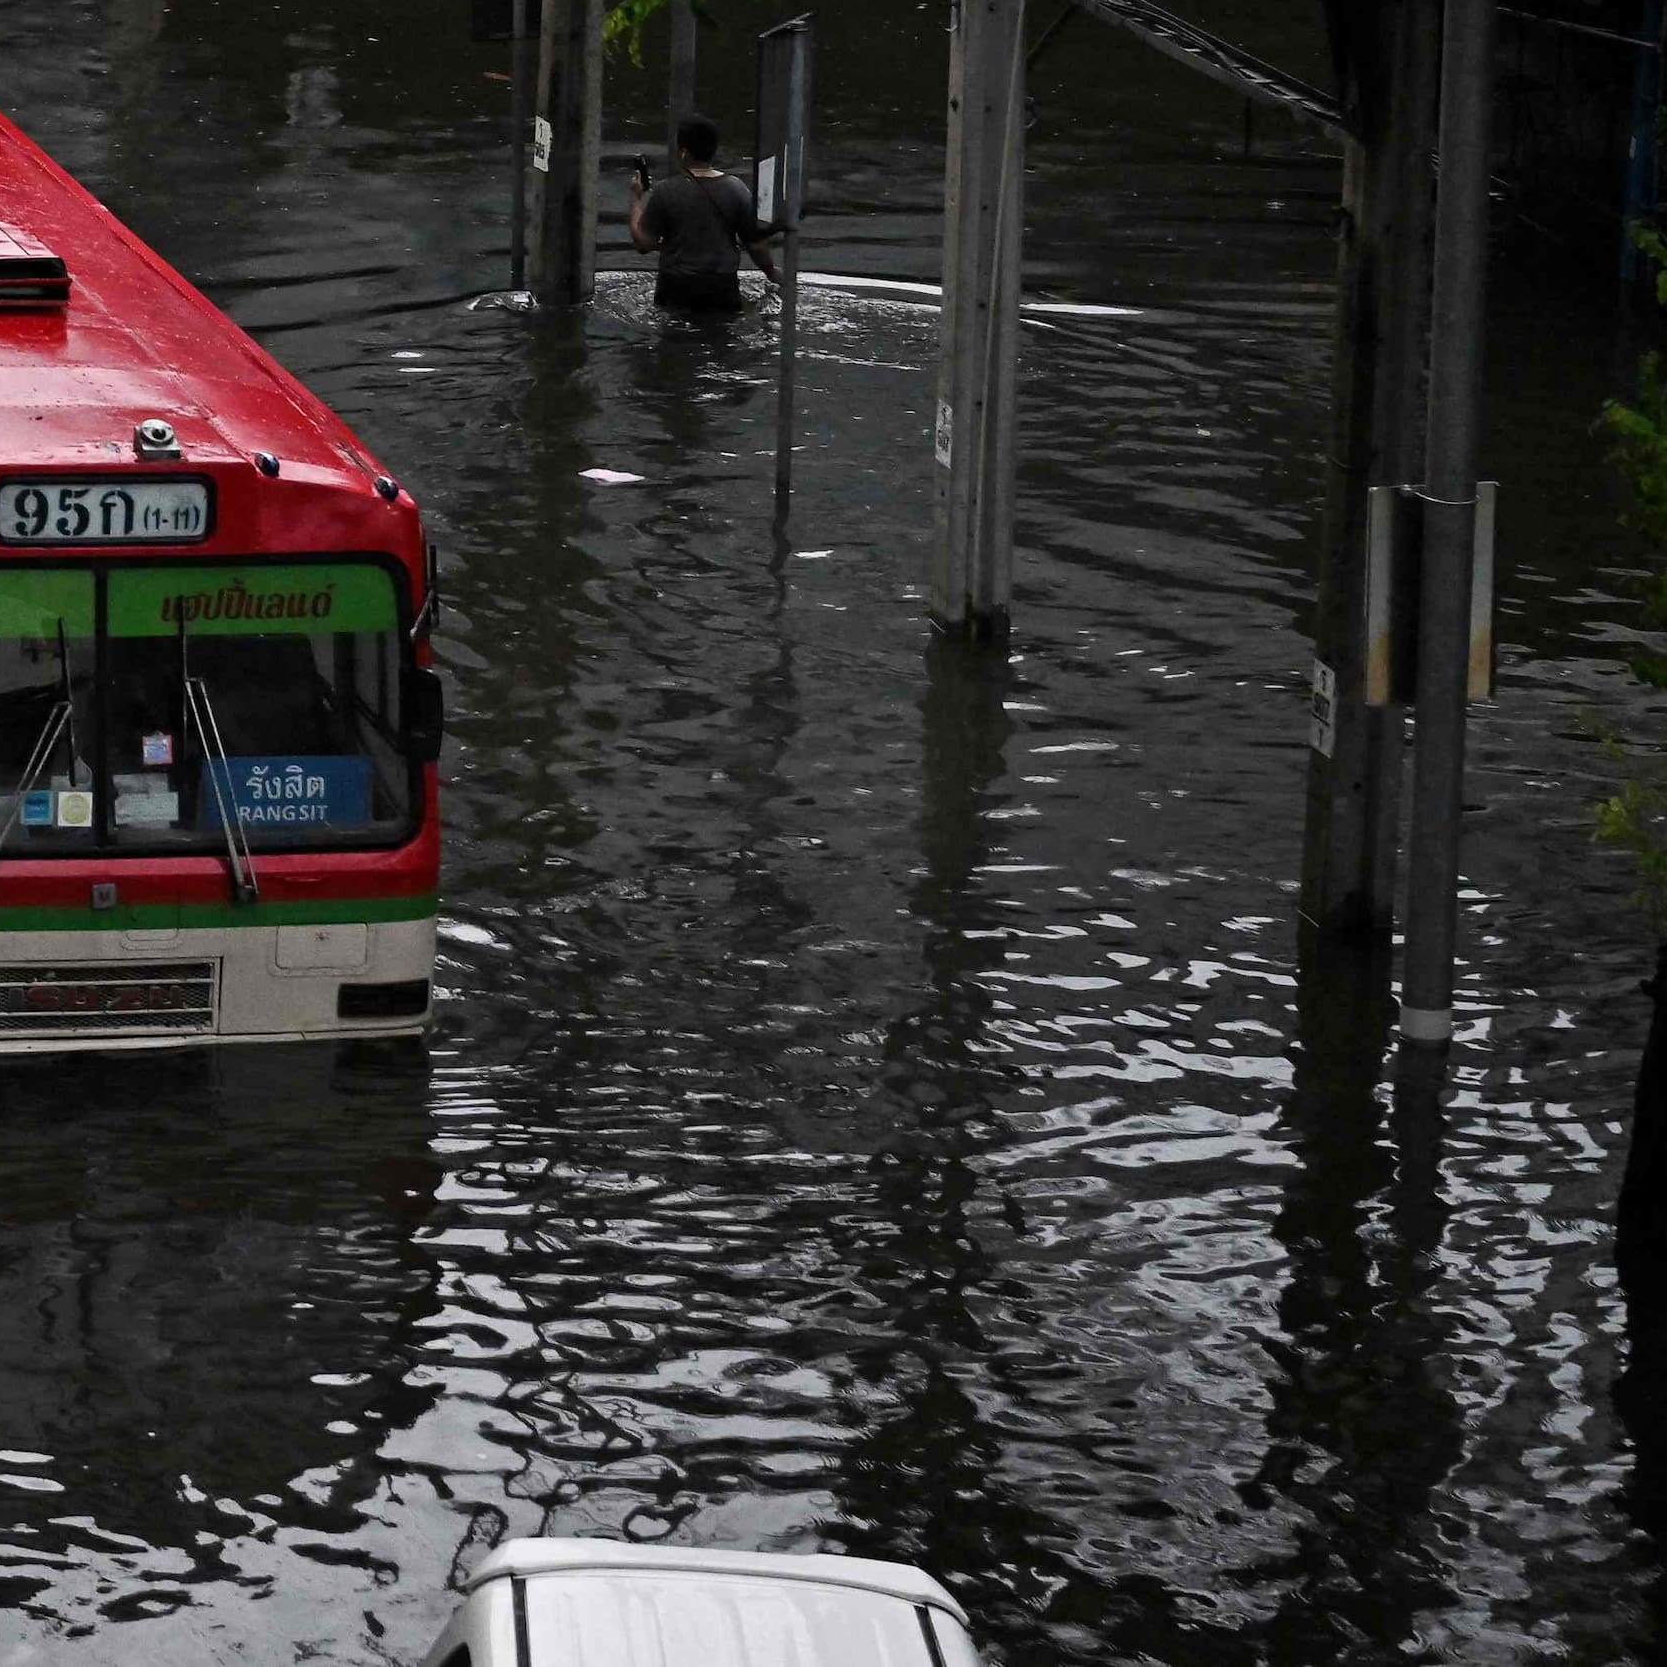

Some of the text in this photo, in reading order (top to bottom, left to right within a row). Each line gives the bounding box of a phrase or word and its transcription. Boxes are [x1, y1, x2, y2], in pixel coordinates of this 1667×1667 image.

[13, 487, 201, 537] 95ก (1-11)
[245, 764, 327, 800] รังสิต
[239, 803, 329, 823] RANGSIT
